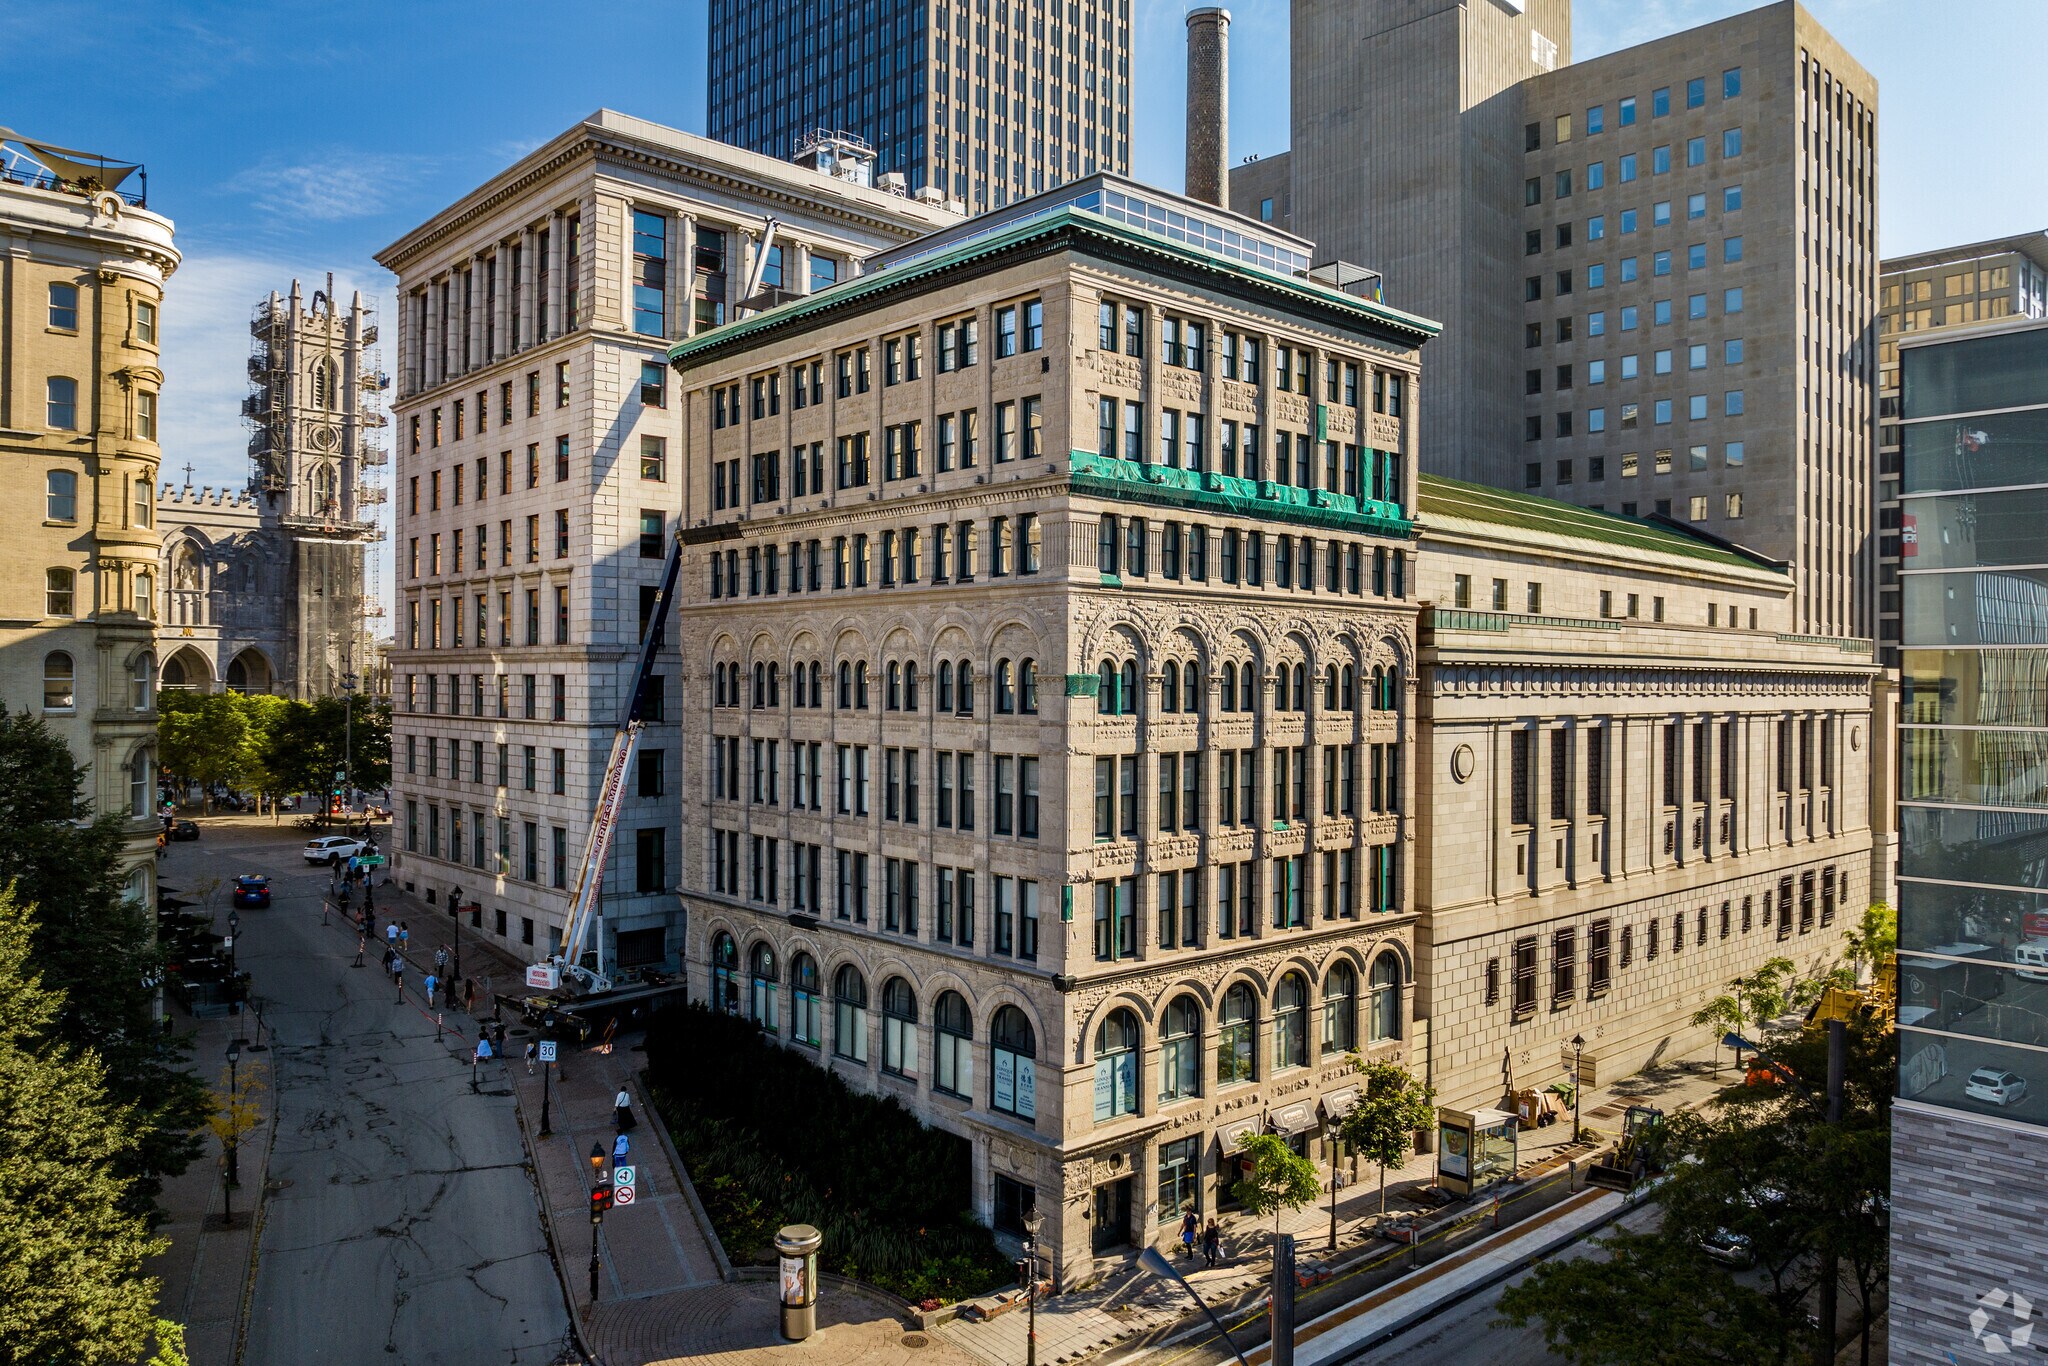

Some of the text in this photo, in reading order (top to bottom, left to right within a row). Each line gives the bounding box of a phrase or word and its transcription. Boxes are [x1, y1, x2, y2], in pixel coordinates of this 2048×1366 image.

[597, 804, 612, 847] GRUES
[607, 748, 628, 803] MONACO
[541, 1046, 554, 1056] 30
